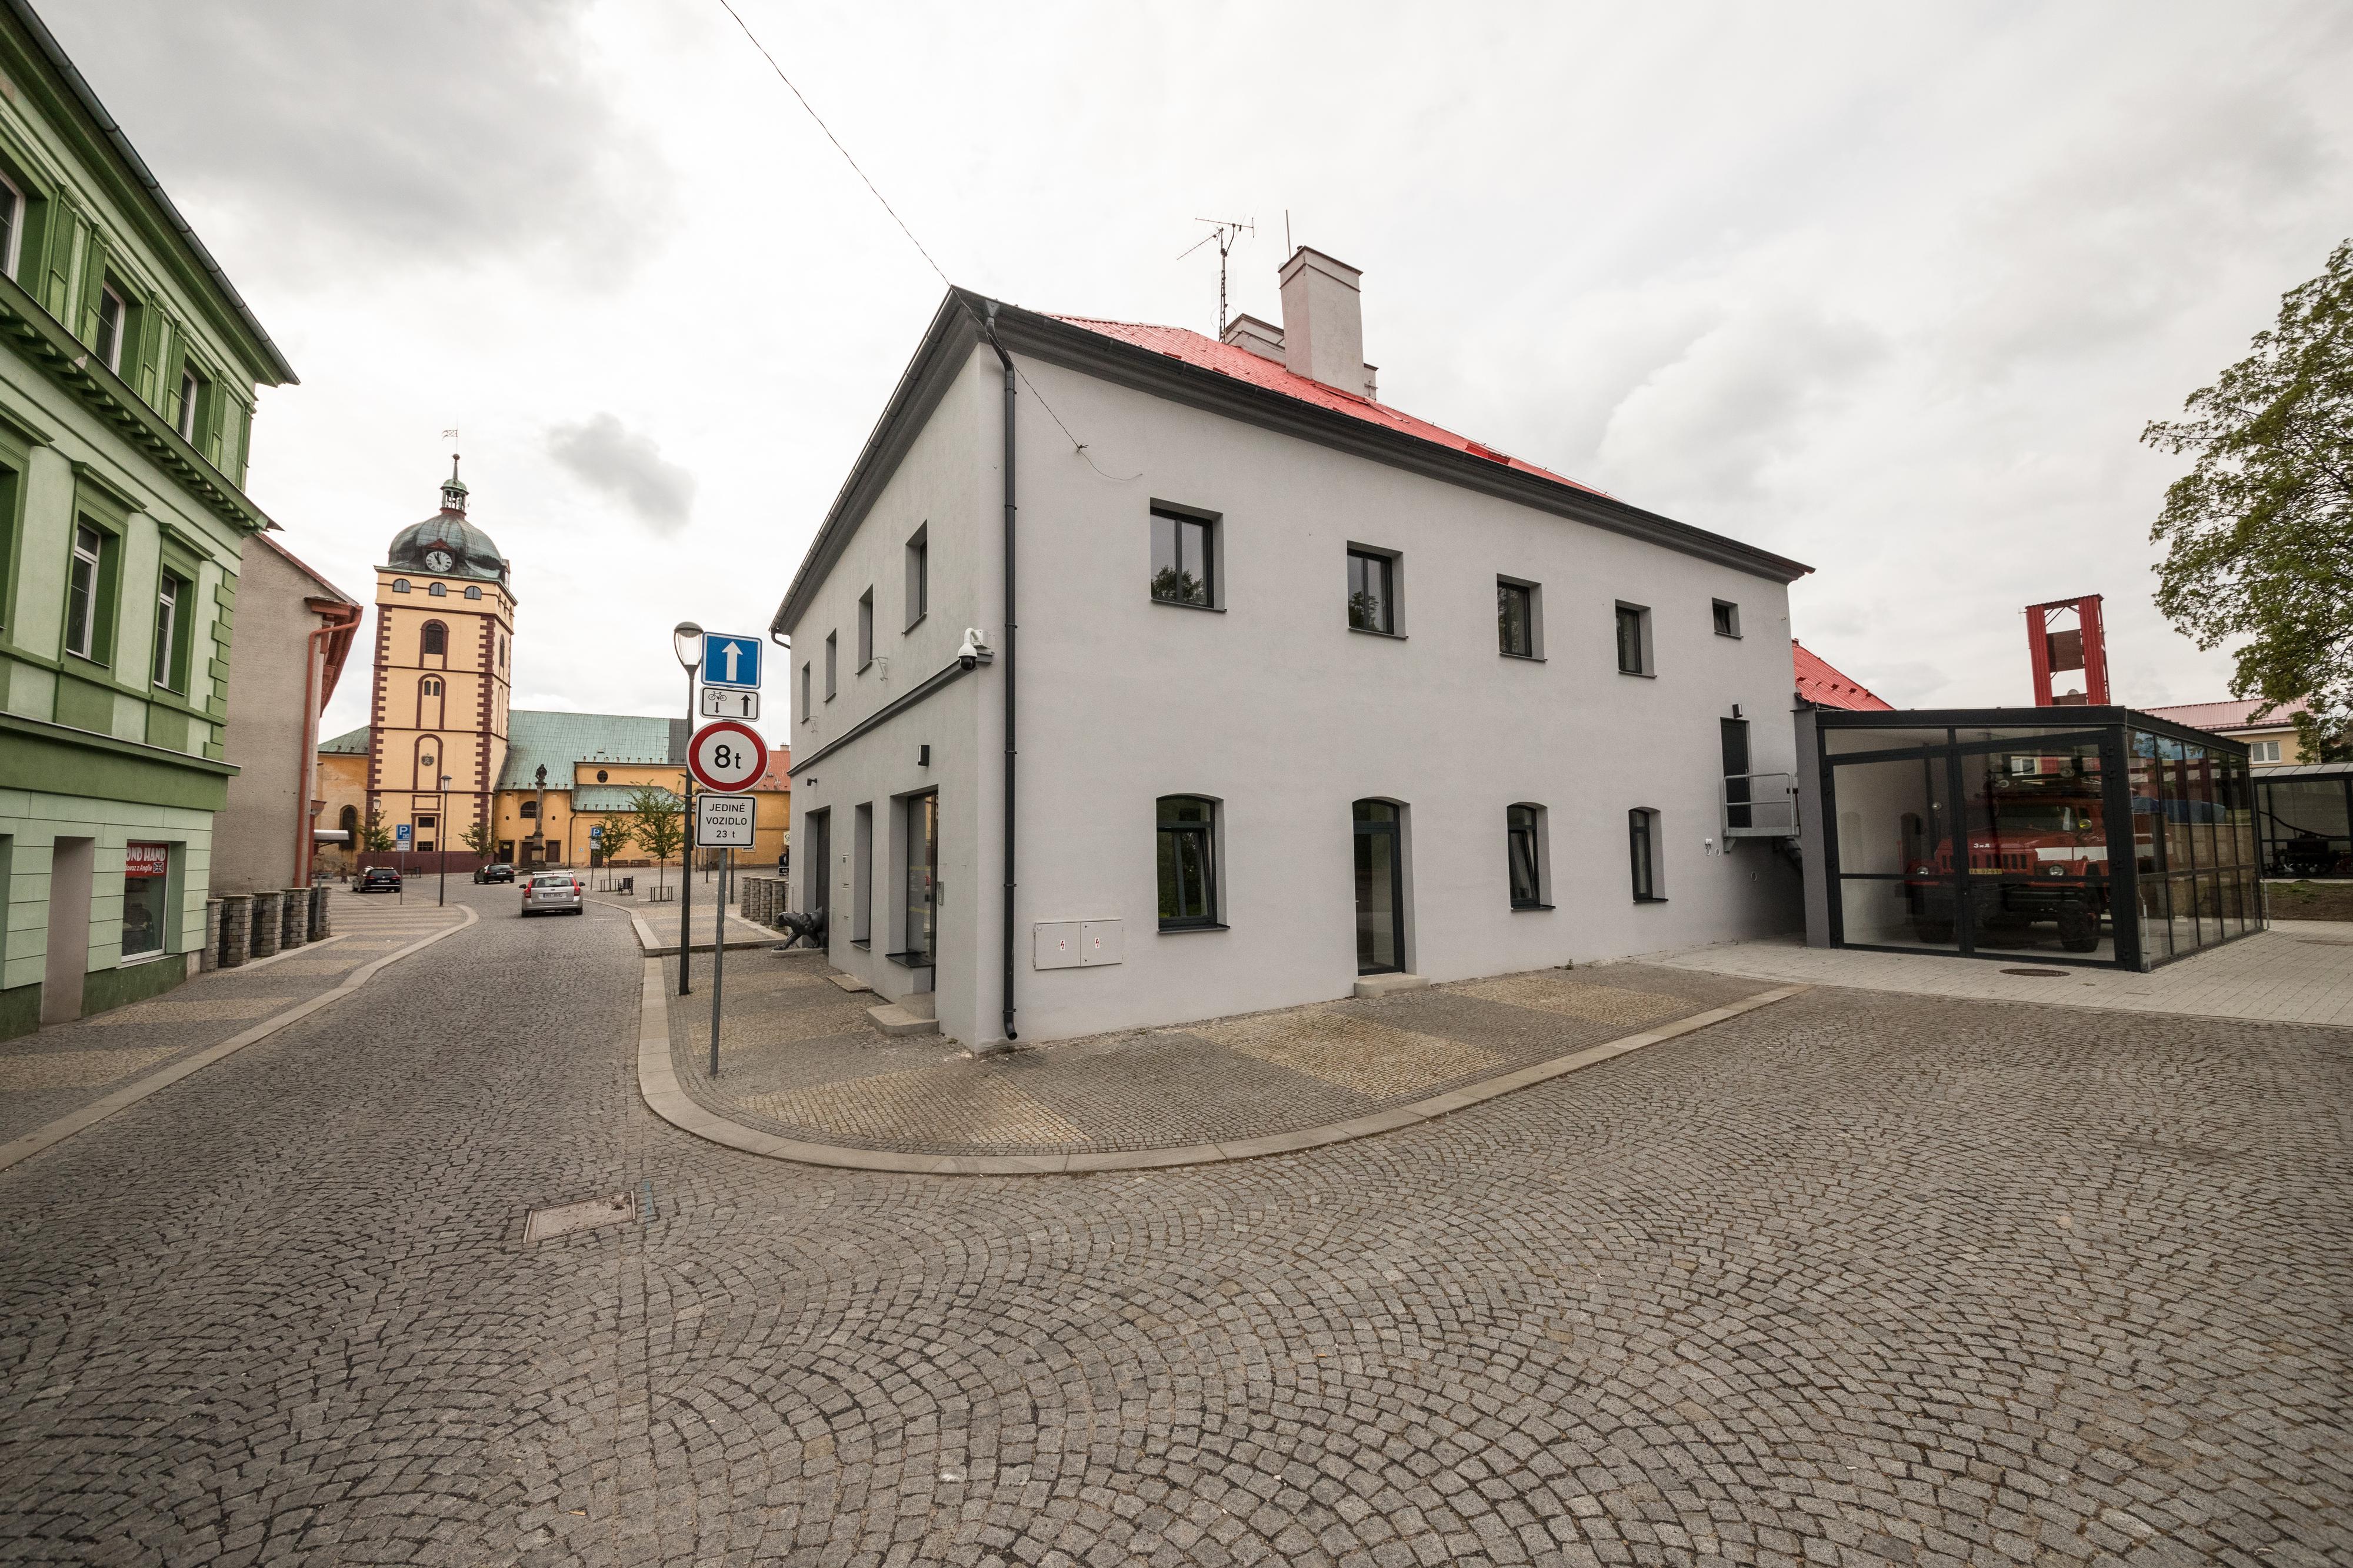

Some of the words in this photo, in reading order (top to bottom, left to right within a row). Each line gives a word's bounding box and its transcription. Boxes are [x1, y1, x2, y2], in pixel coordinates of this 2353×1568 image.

[709, 802, 745, 812] JEDINÉ
[706, 816, 747, 825] VOZIDLO
[399, 826, 408, 835] P
[716, 830, 728, 838] 23
[144, 848, 166, 862] HAND
[139, 864, 152, 873] Anglie
